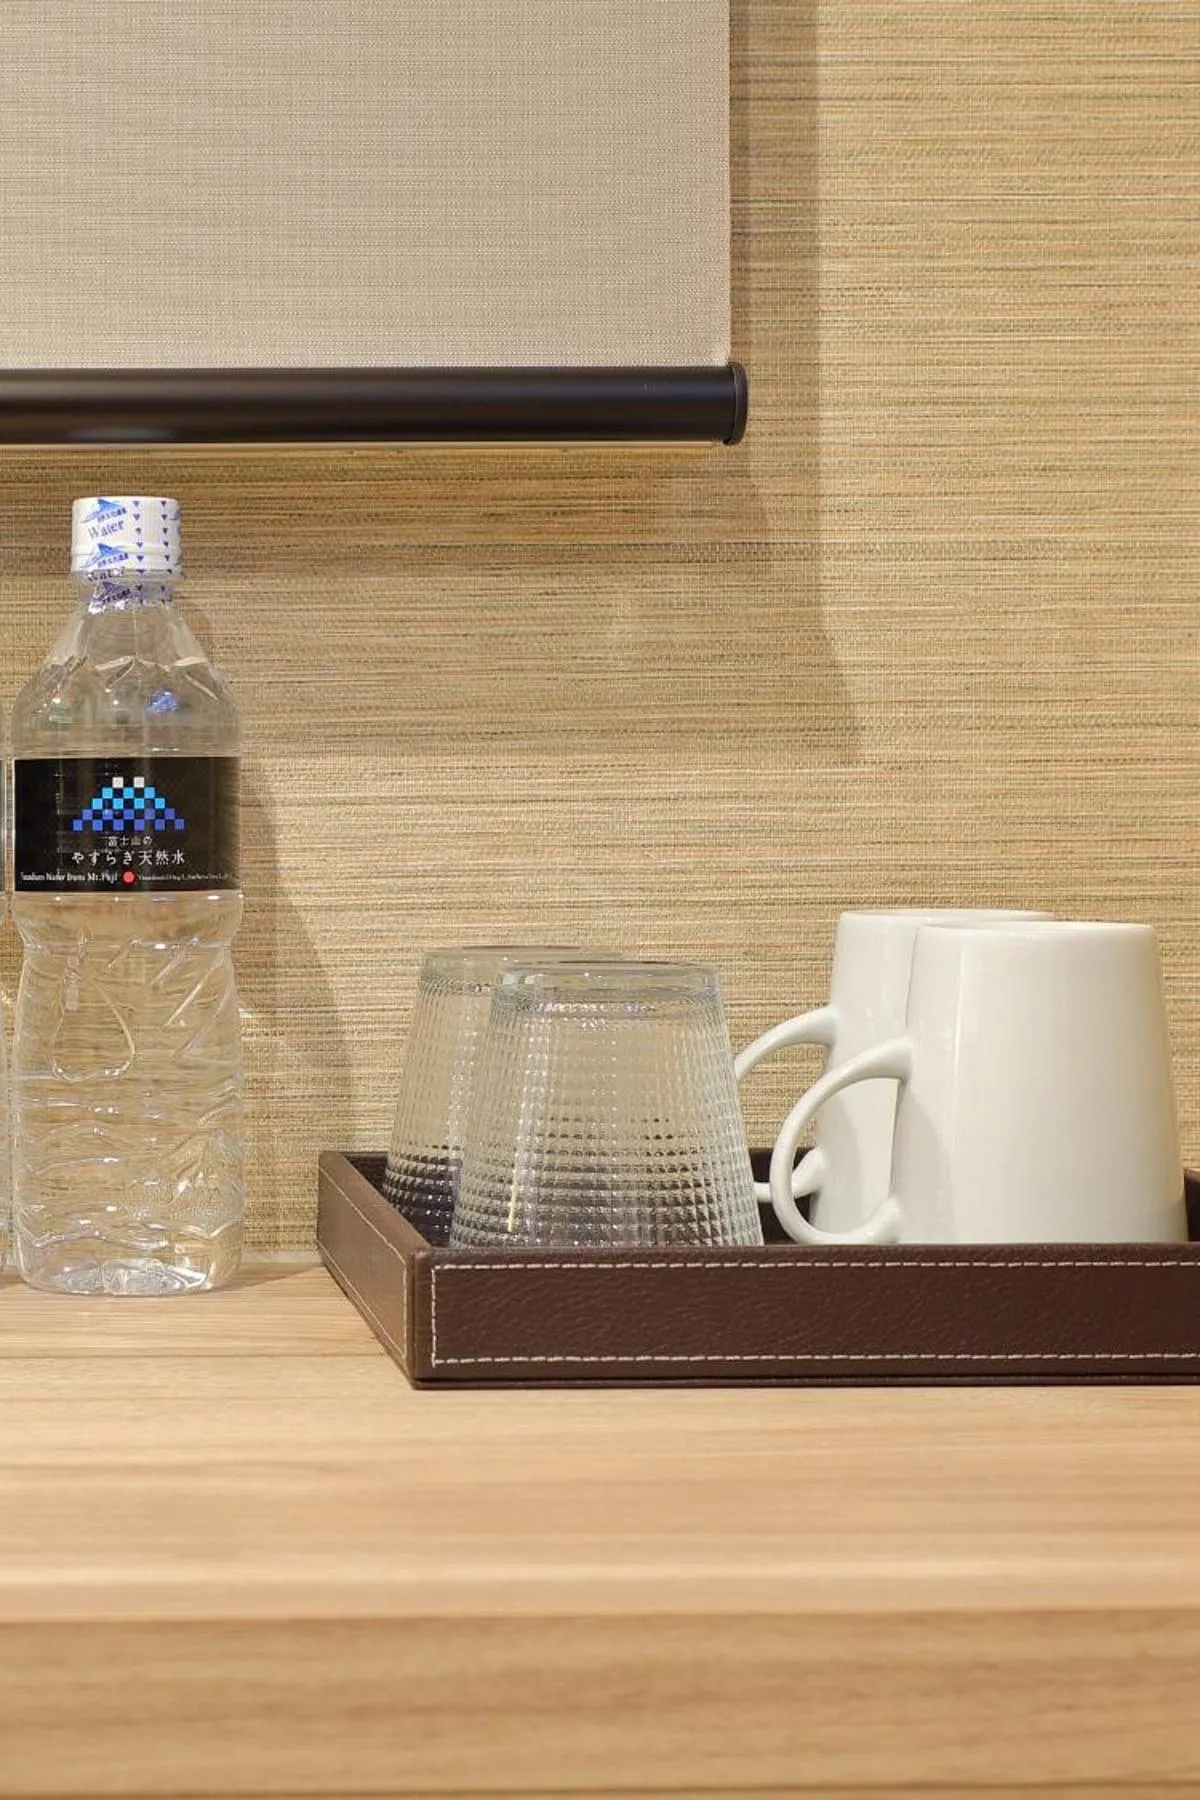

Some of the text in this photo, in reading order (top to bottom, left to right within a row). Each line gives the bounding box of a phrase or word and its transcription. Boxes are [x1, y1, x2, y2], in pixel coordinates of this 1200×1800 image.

[107, 835, 153, 847] 富士山の
[71, 849, 186, 866] やすらぎ天然水
